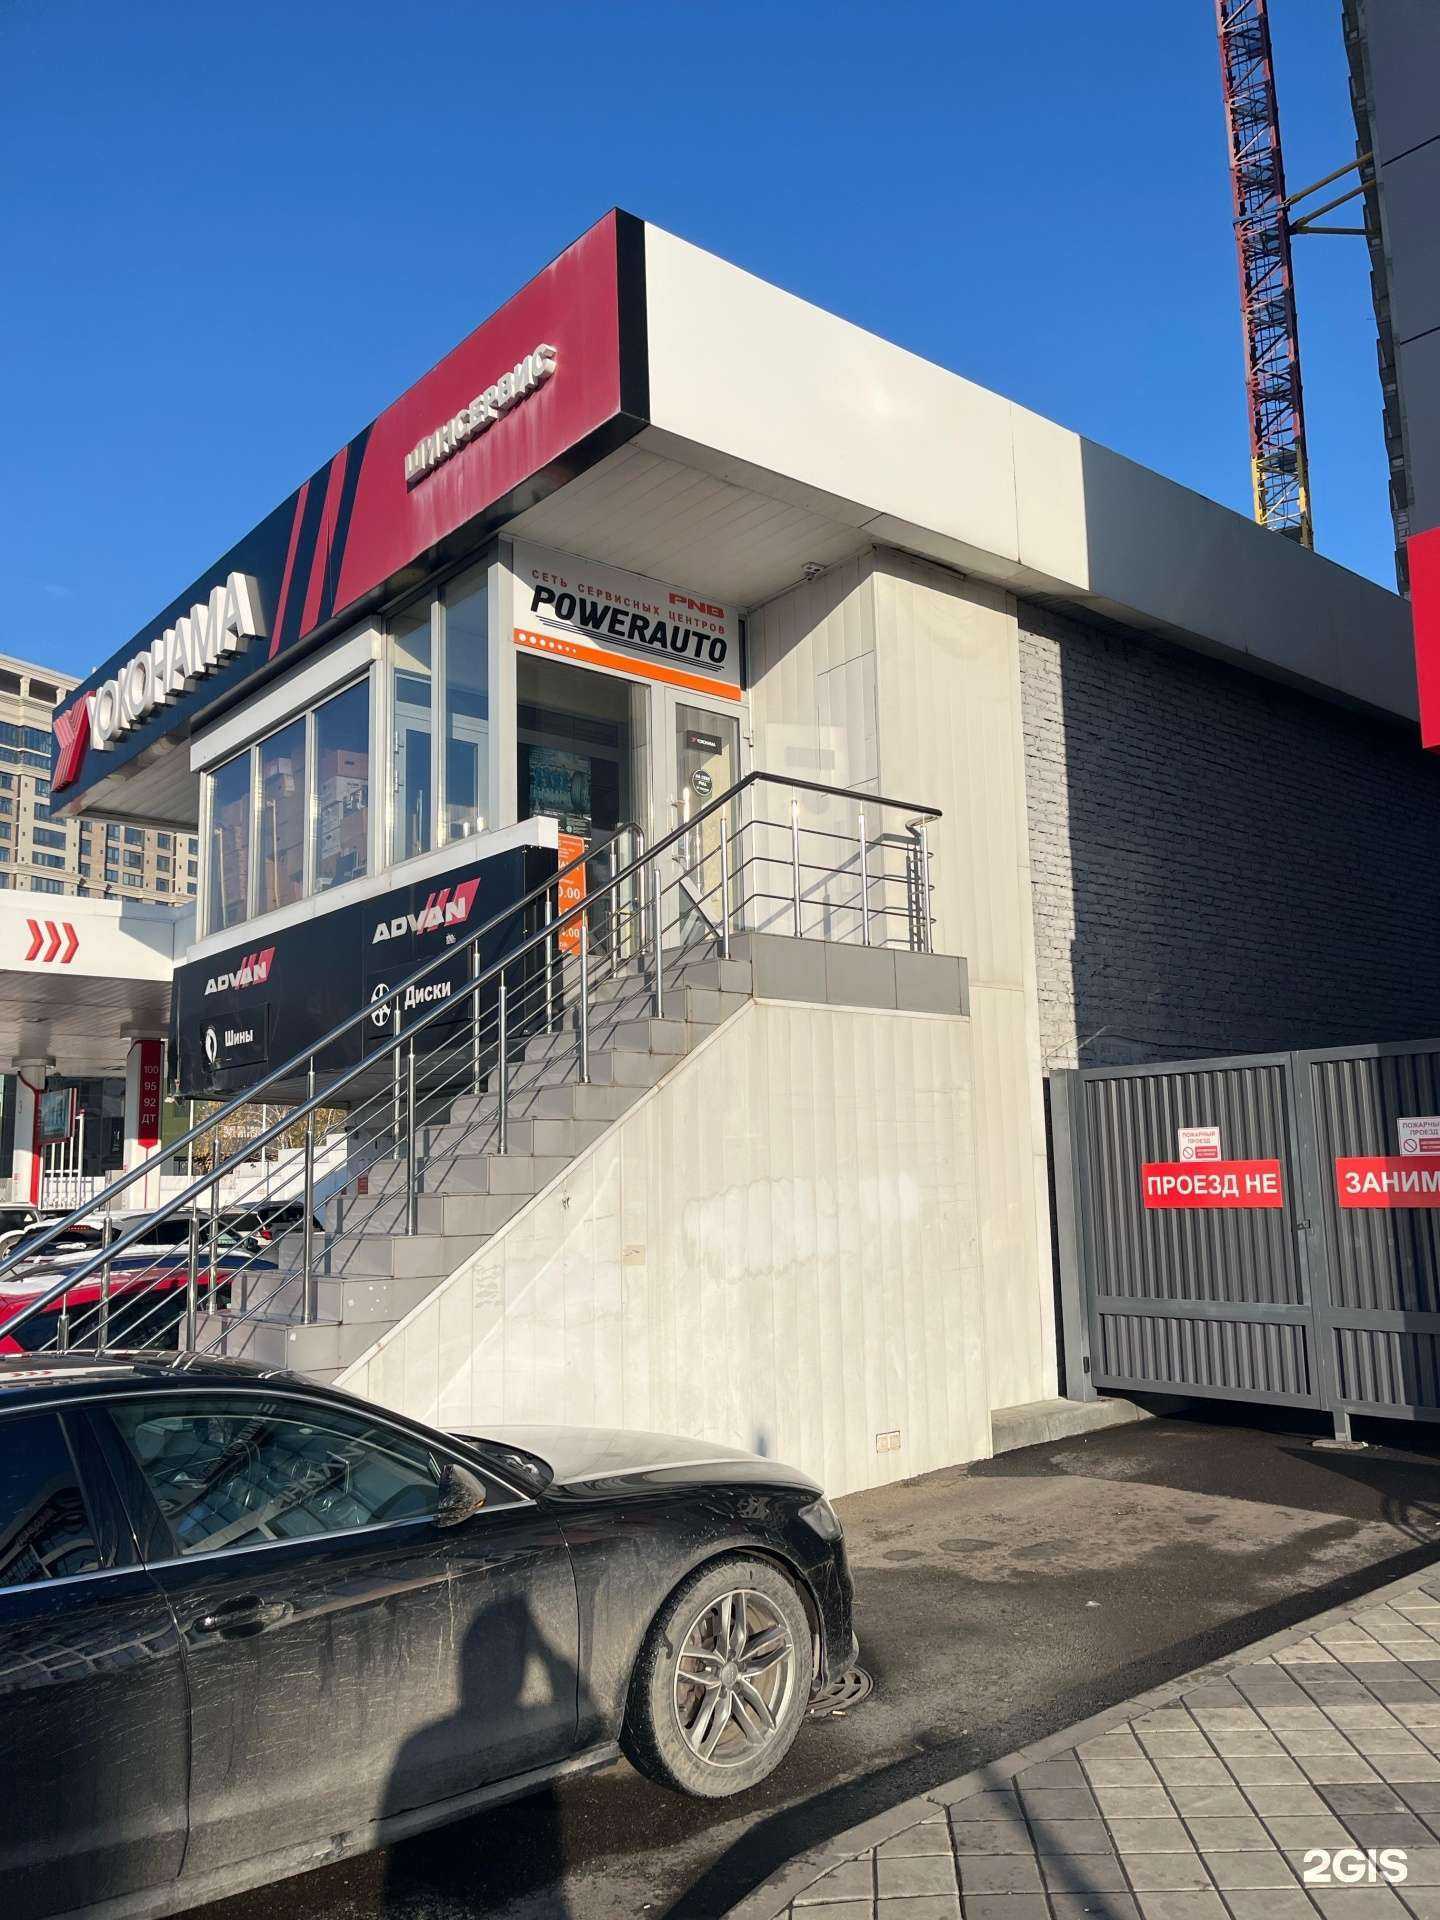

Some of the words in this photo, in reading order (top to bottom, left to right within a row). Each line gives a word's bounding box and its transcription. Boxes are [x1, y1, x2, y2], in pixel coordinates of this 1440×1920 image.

[404, 343, 557, 482] ШИНСЕРВИС
[531, 569, 569, 589] СЕТЬ
[577, 583, 661, 617] СЕРВИСНЫХ
[668, 610, 726, 636] ЦЕНТРОВ
[668, 591, 726, 620] PNB
[530, 584, 728, 664] POWERAUTO
[86, 571, 267, 751] YOKOHAMA
[372, 896, 467, 945] ADVAN
[204, 961, 268, 996] ADVAN
[403, 981, 451, 1011] Диски
[224, 1029, 255, 1048] Шины
[143, 1065, 159, 1075] 100
[144, 1081, 158, 1092] 95
[143, 1097, 157, 1108] 92
[141, 1113, 157, 1126] ДТ
[1147, 1174, 1239, 1197] ПРОЕЗД
[1245, 1173, 1278, 1194] НЕ
